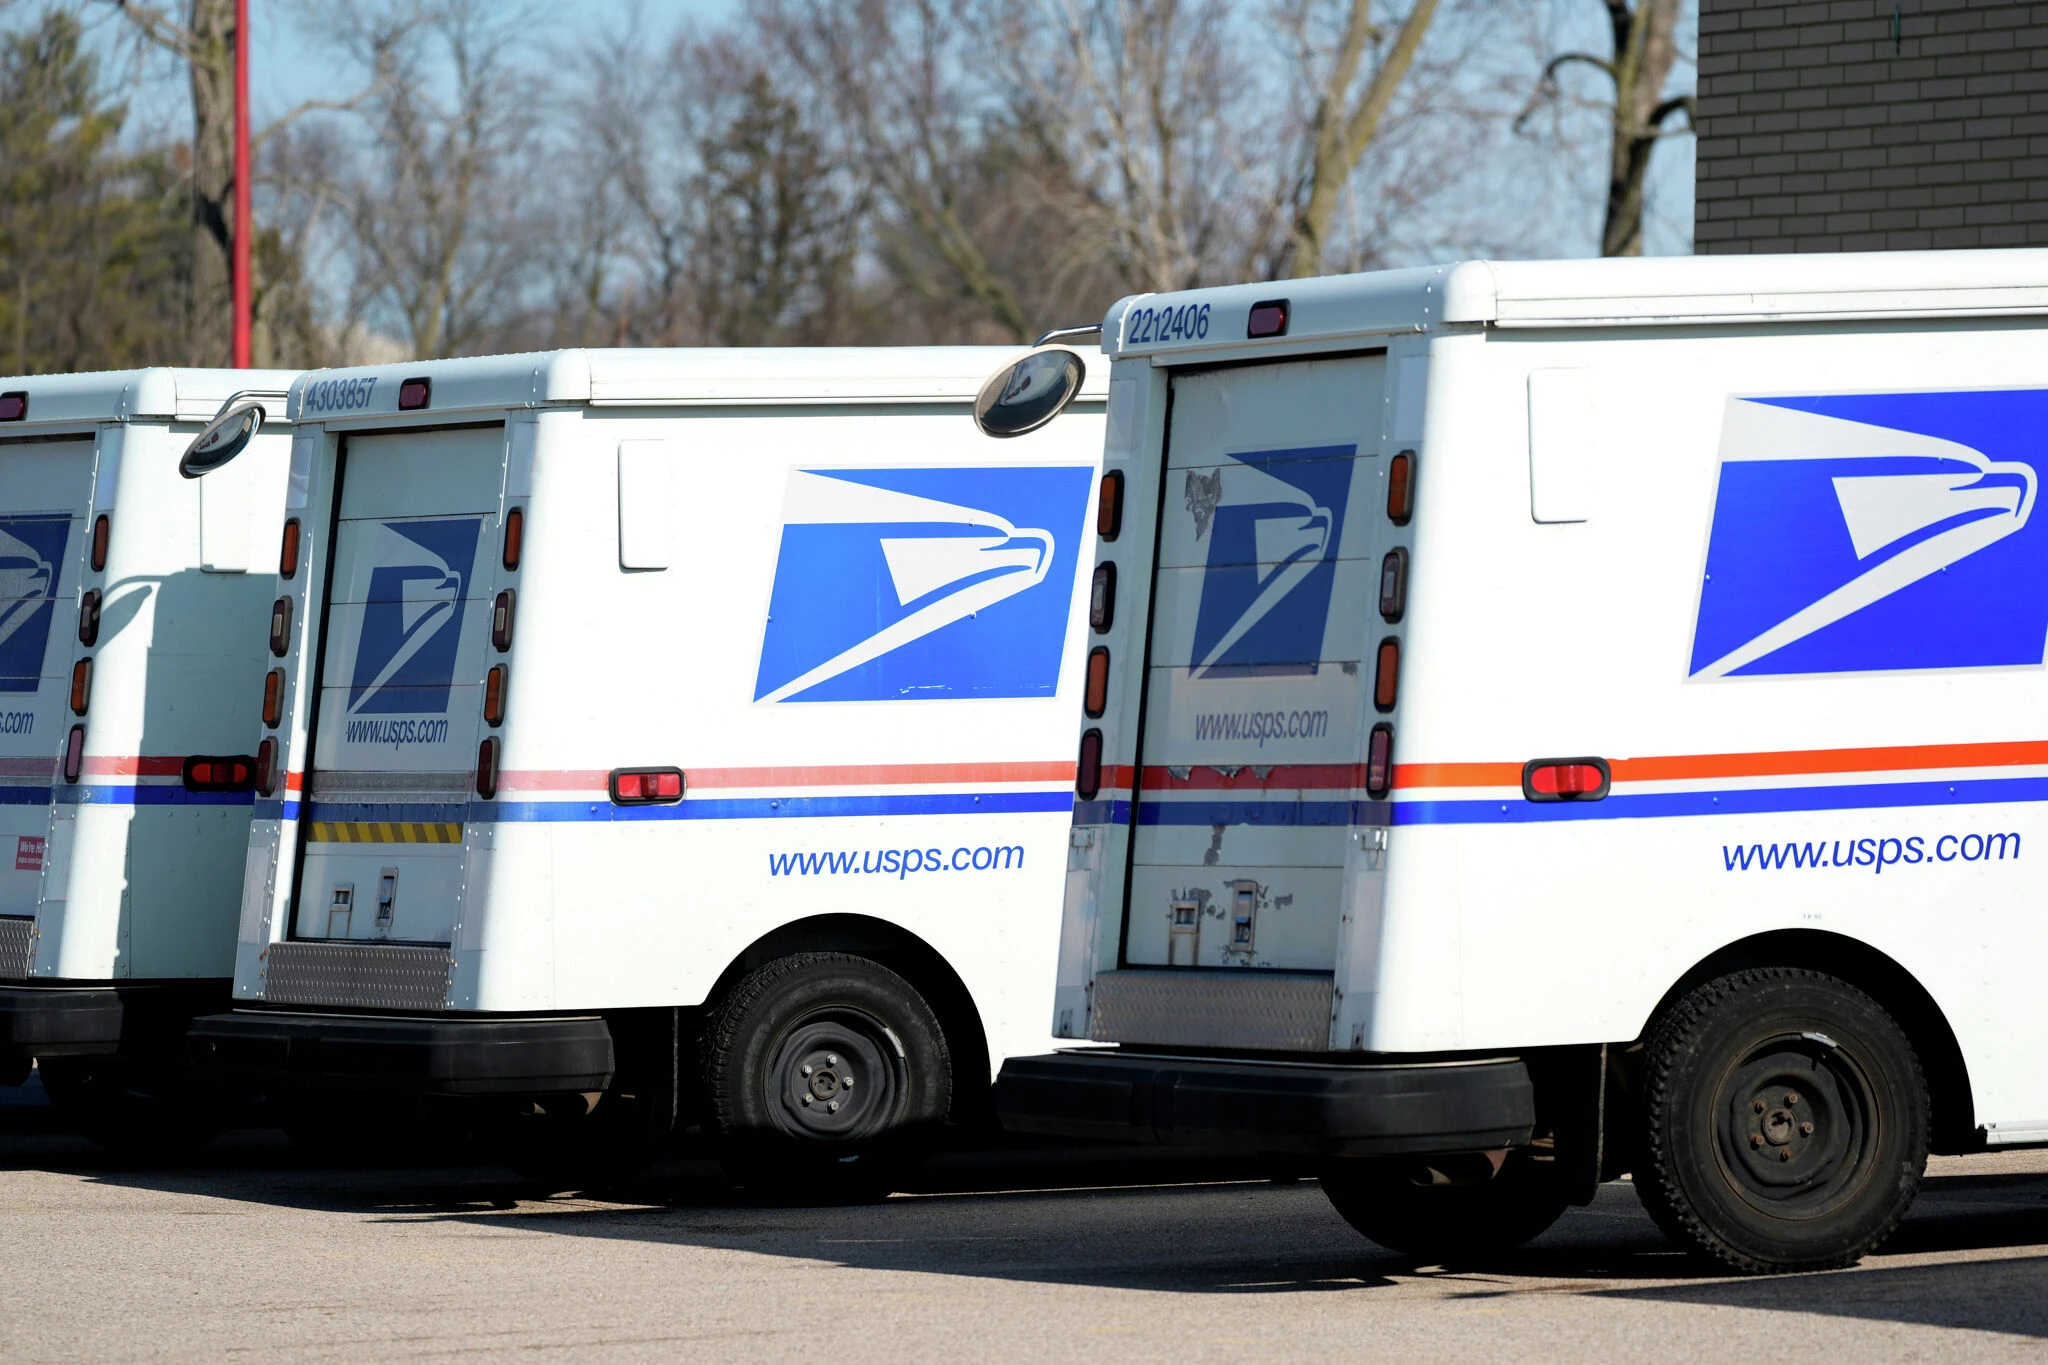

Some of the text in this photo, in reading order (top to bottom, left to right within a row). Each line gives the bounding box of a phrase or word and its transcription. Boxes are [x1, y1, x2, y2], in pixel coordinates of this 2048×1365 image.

[1128, 303, 1211, 344] 2212406
[306, 376, 378, 412] 4303857
[346, 719, 449, 751] www.usps.com
[1195, 710, 1328, 748] www.usps.com
[769, 845, 1025, 880] www.usps.com
[1722, 832, 2021, 874] www.usps.com
